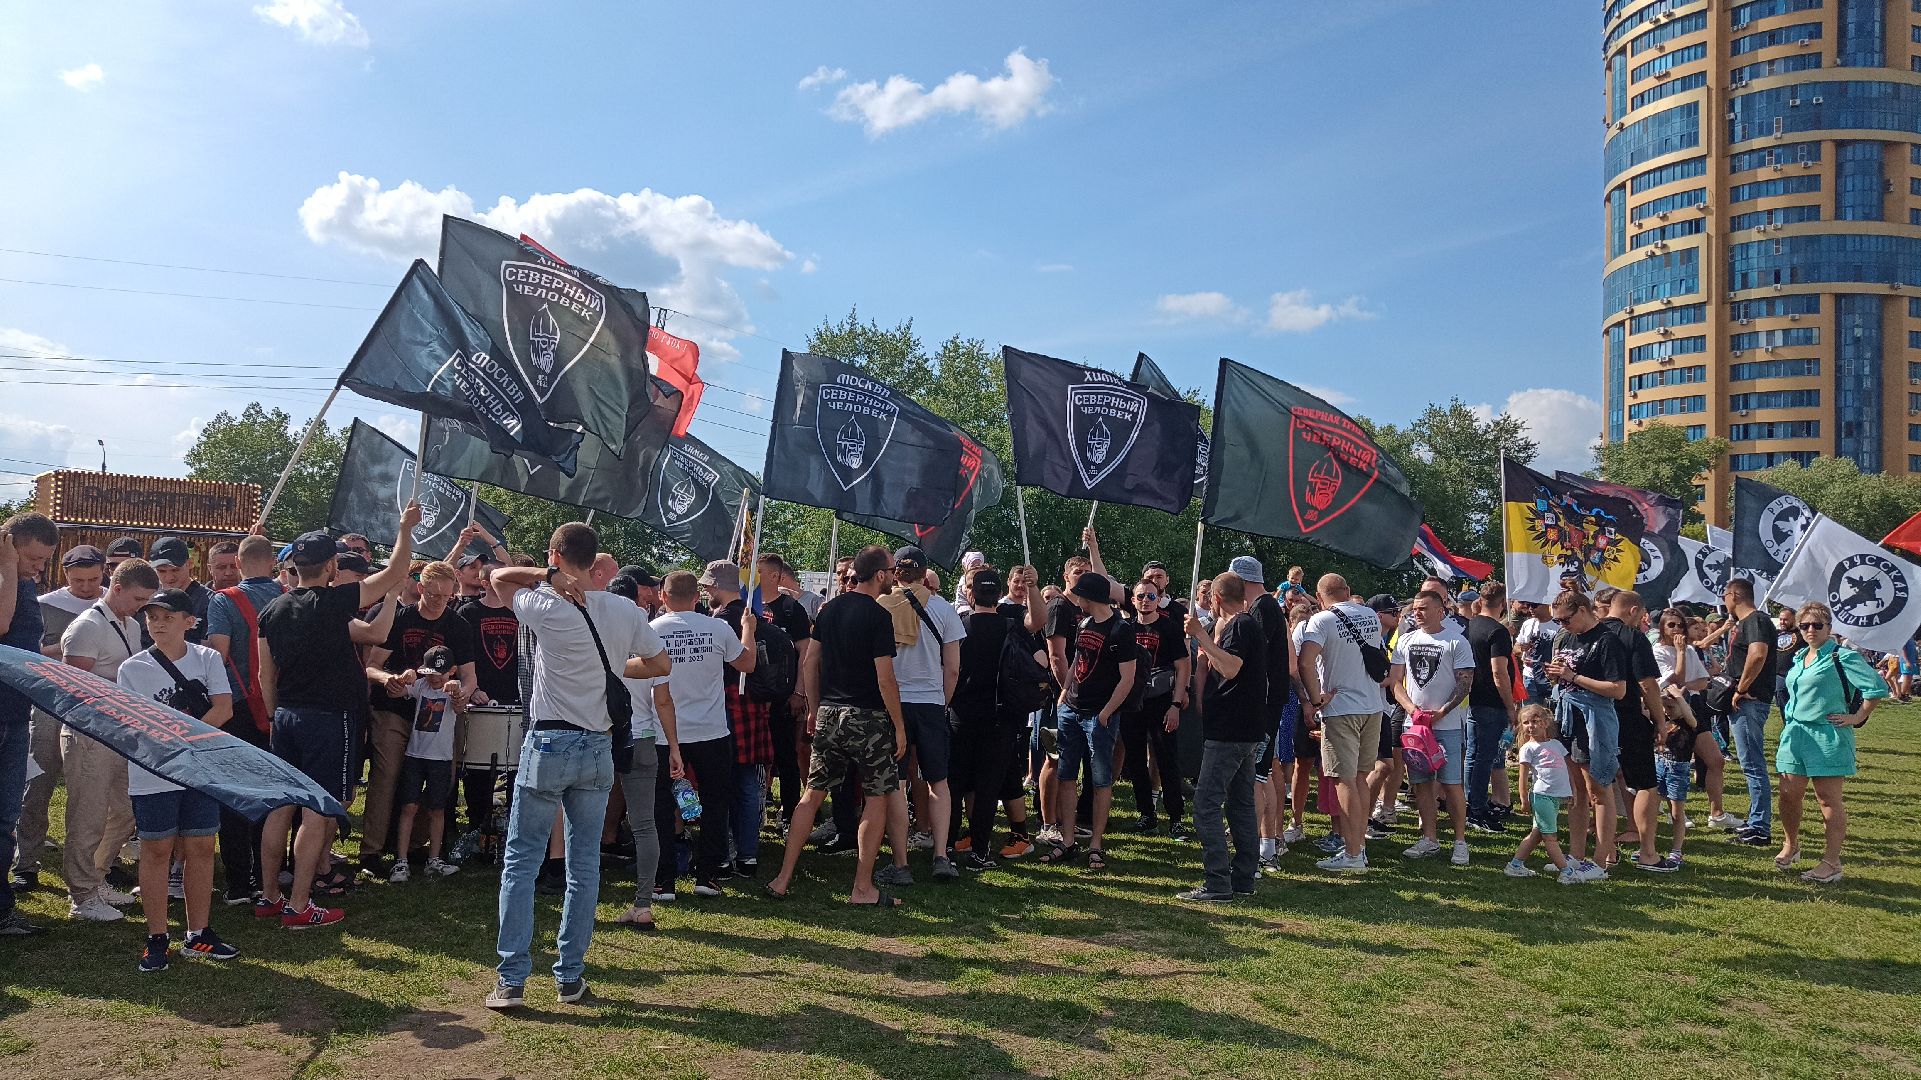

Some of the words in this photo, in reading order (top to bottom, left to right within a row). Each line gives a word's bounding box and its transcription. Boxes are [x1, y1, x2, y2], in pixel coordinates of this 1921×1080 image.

[505, 267, 601, 312] СЕВЕРНЫЙ
[512, 283, 593, 321] ЧЕЛОВЕК
[471, 351, 525, 404] МОСКВА
[836, 373, 891, 398] МОСКВА
[453, 357, 518, 430] СЕВЕРНЫЙ
[822, 388, 895, 413] СЕВЕРНЫЙ
[1074, 394, 1140, 413] СЕВЕРНЫЙ
[827, 401, 889, 421] ЧЕЛОВЕК
[1080, 406, 1133, 422] ЧЕЛОВЕК
[1291, 405, 1342, 425] СЕВЕРНАЯ
[671, 449, 715, 483] СЕВЕРНЫЙ
[1842, 554, 1908, 598] РУССКАЯ
[1829, 591, 1881, 626] ОБЩИНА
[688, 655, 704, 663] 2023
